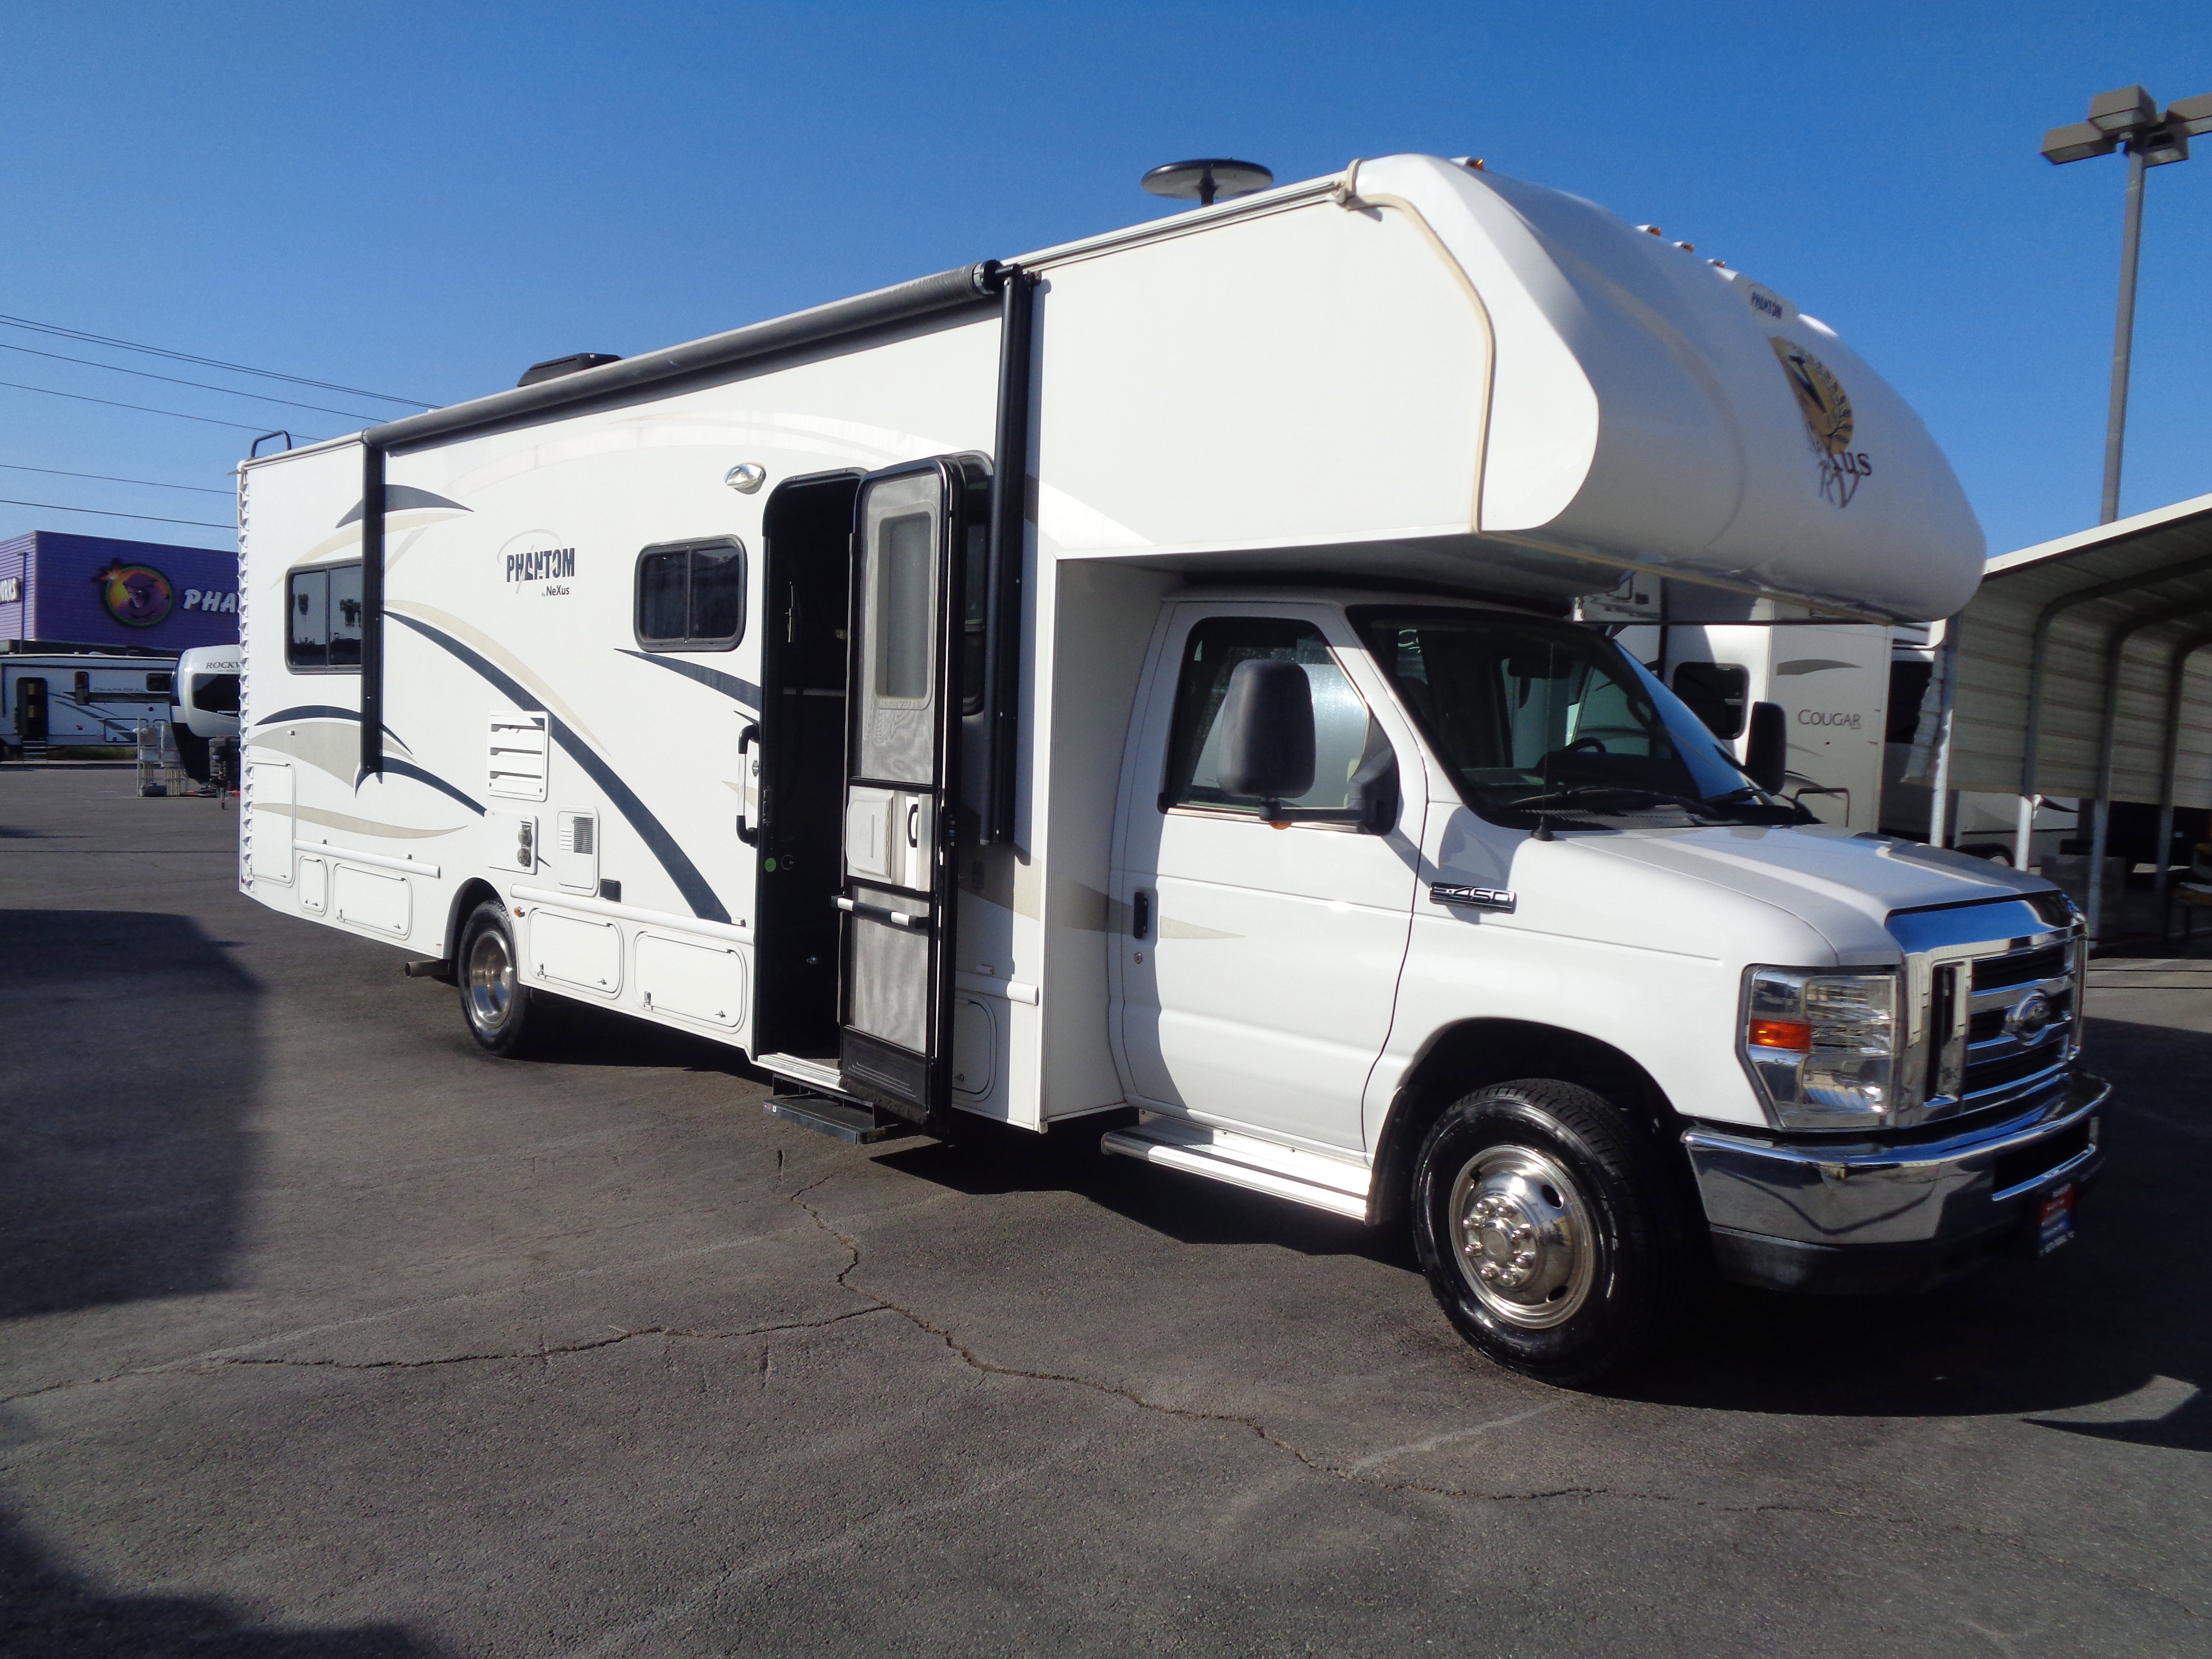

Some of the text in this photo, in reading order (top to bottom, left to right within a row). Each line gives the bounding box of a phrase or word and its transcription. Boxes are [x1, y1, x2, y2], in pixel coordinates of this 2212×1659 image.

[506, 547, 575, 582] PHANTOM
[183, 589, 236, 613] PHA
[546, 585, 570, 596] NeXus
[1798, 709, 1861, 728] COUGAR
